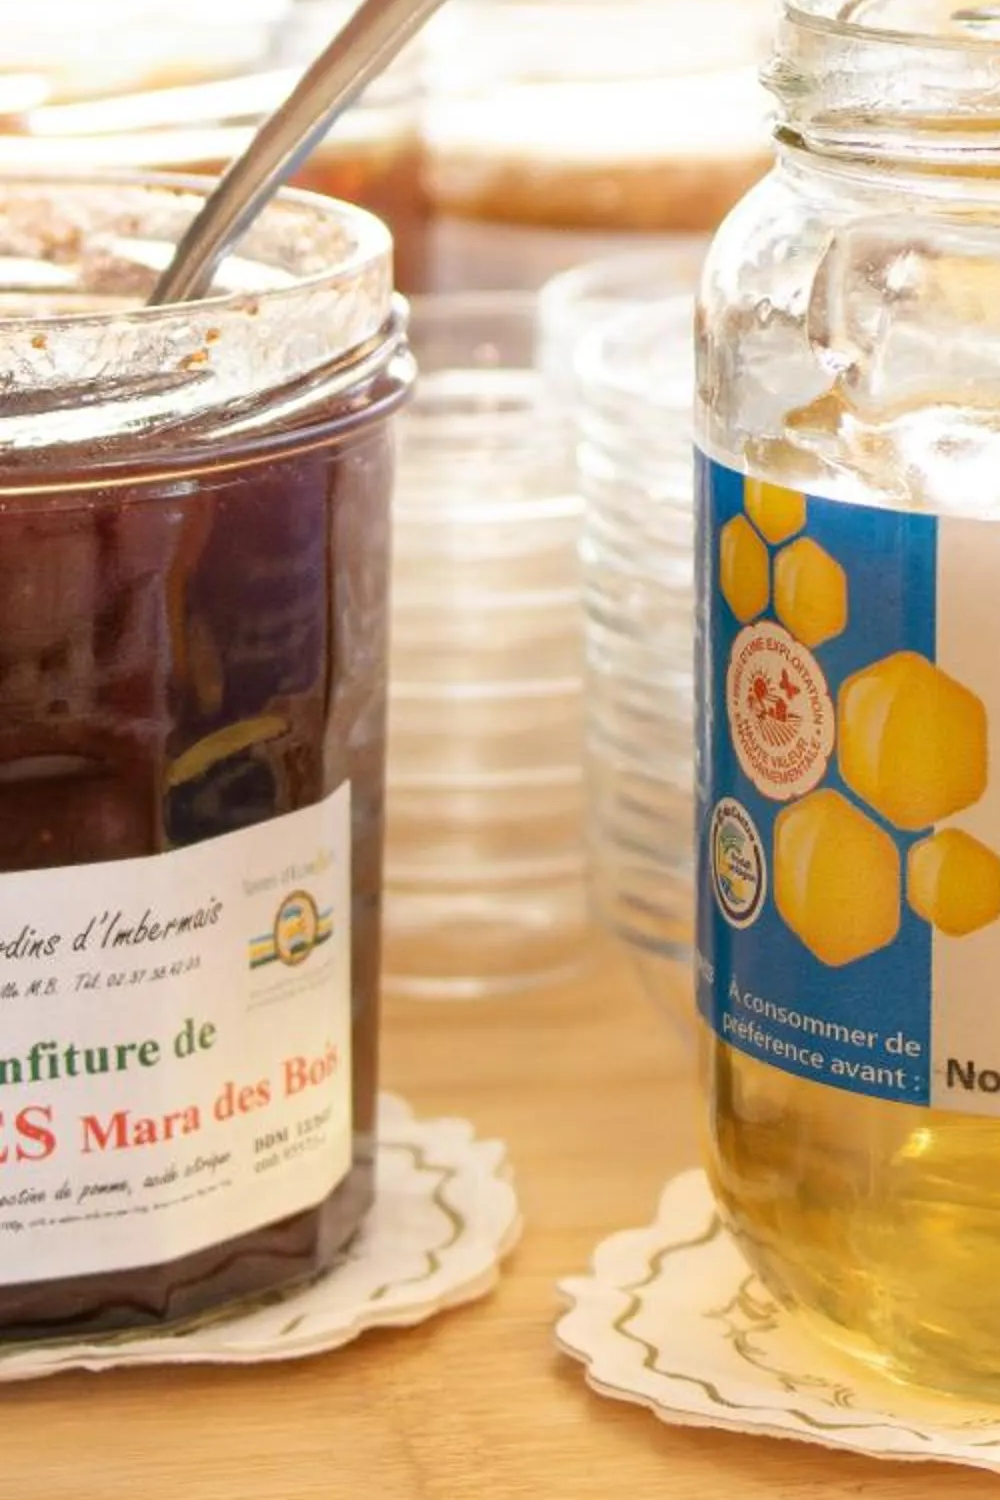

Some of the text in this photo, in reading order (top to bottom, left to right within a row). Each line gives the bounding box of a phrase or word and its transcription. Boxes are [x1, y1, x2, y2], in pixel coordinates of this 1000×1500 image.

[174, 1017, 217, 1059] de
[723, 1011, 824, 1070] préférence
[831, 1058, 907, 1090] avant
[744, 992, 878, 1049] consommer
[885, 1031, 921, 1057] de
[0, 1104, 57, 1165] S
[79, 1104, 200, 1154] Mara
[213, 1080, 271, 1122] des
[282, 1037, 338, 1099] Bois
